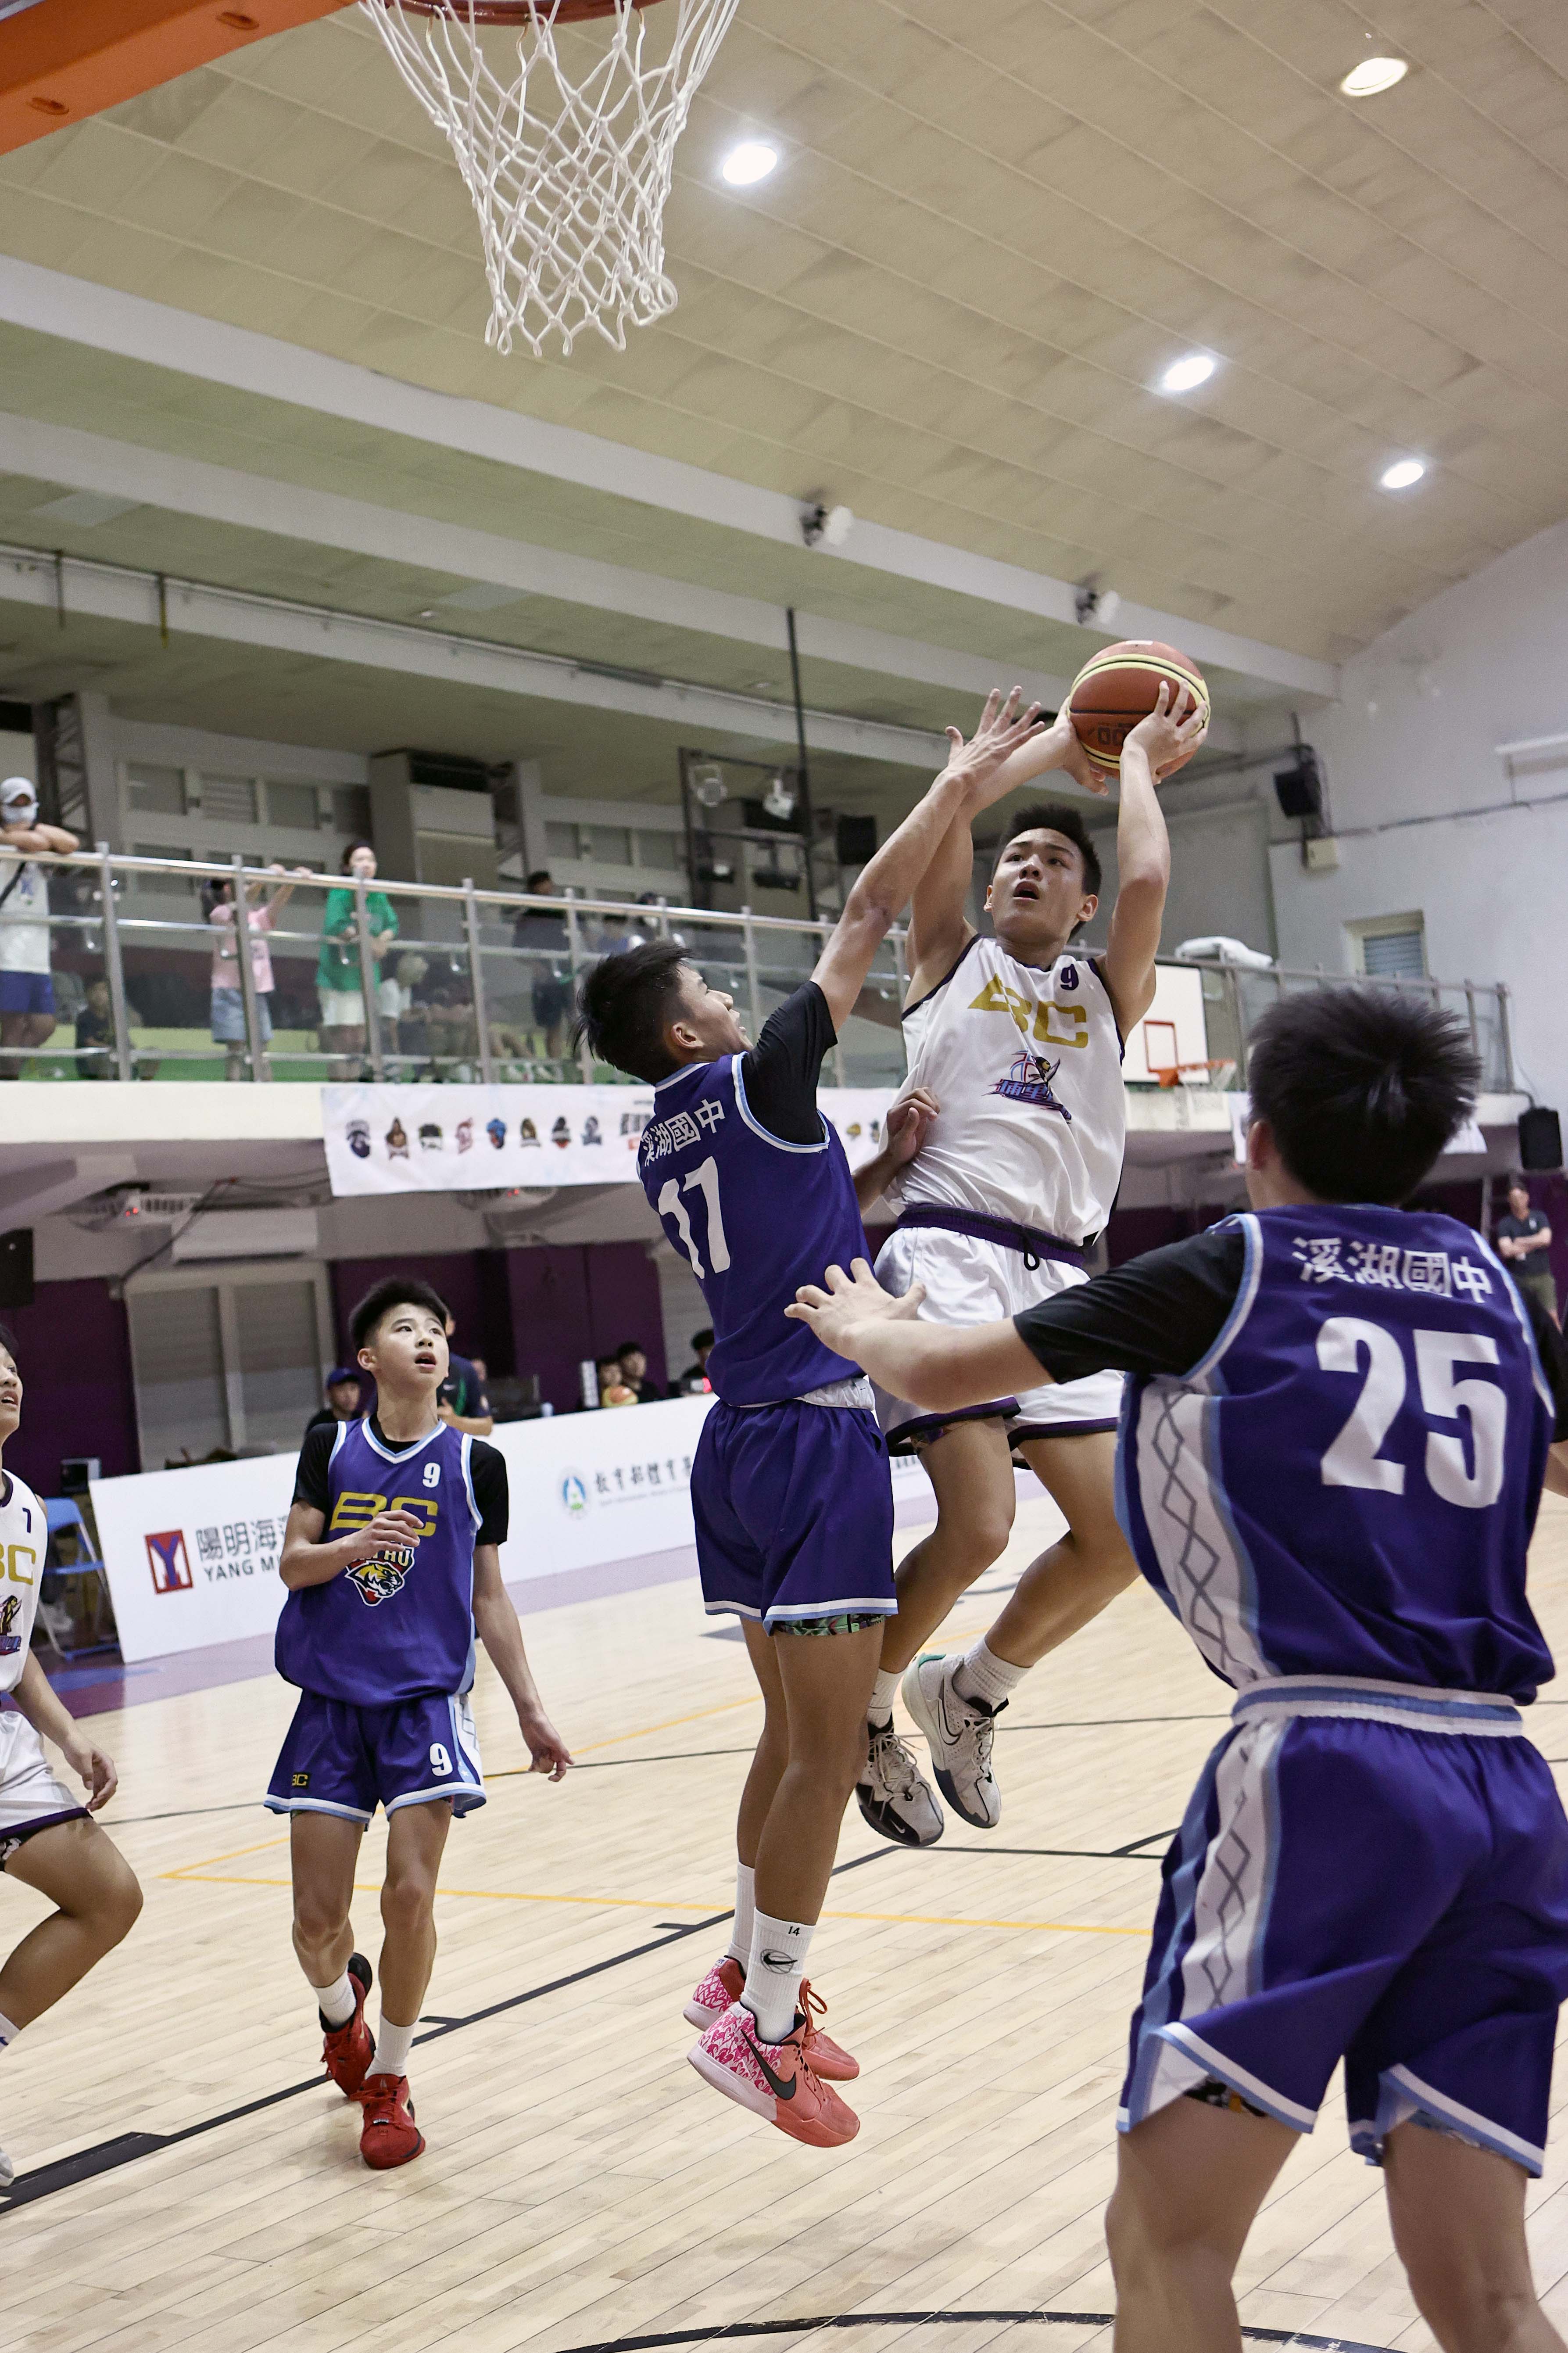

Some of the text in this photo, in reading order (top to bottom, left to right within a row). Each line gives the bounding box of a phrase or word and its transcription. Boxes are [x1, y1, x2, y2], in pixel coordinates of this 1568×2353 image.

[1060, 964, 1079, 990] 9
[641, 1098, 726, 1167] 溪湖國中
[658, 1156, 730, 1279] 17
[1292, 1237, 1493, 1304] 溪湖國中
[1315, 1316, 1507, 1509] 25
[422, 1462, 441, 1488] 9
[329, 1492, 438, 1537] BC
[0, 1542, 36, 1585] C
[204, 1558, 254, 1582] YANG
[429, 1743, 453, 1776] 9
[788, 1926, 800, 1936] 14
